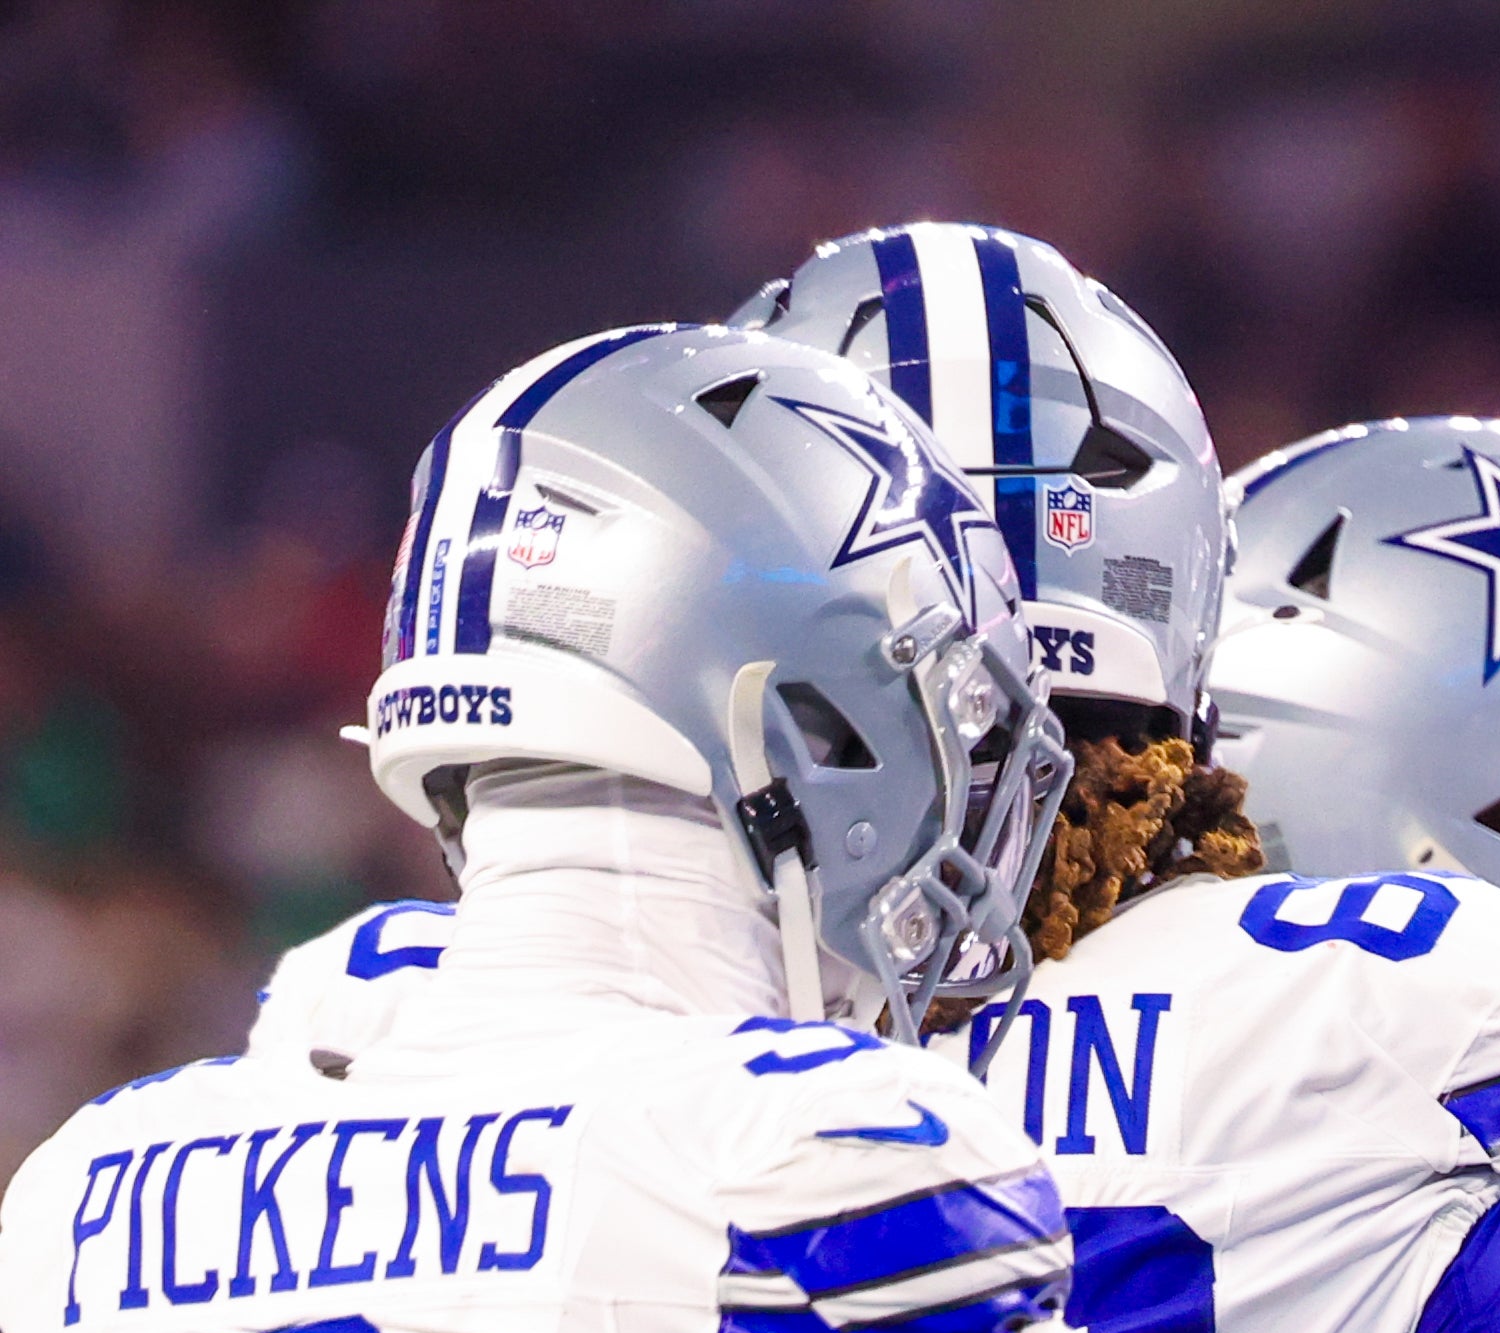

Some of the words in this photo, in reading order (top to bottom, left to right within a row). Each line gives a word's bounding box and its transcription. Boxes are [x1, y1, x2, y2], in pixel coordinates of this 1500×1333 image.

[1052, 511, 1089, 542] NFL
[1027, 625, 1095, 676] YS
[966, 993, 1173, 1155] ON
[63, 1106, 575, 1326] PICKENS
